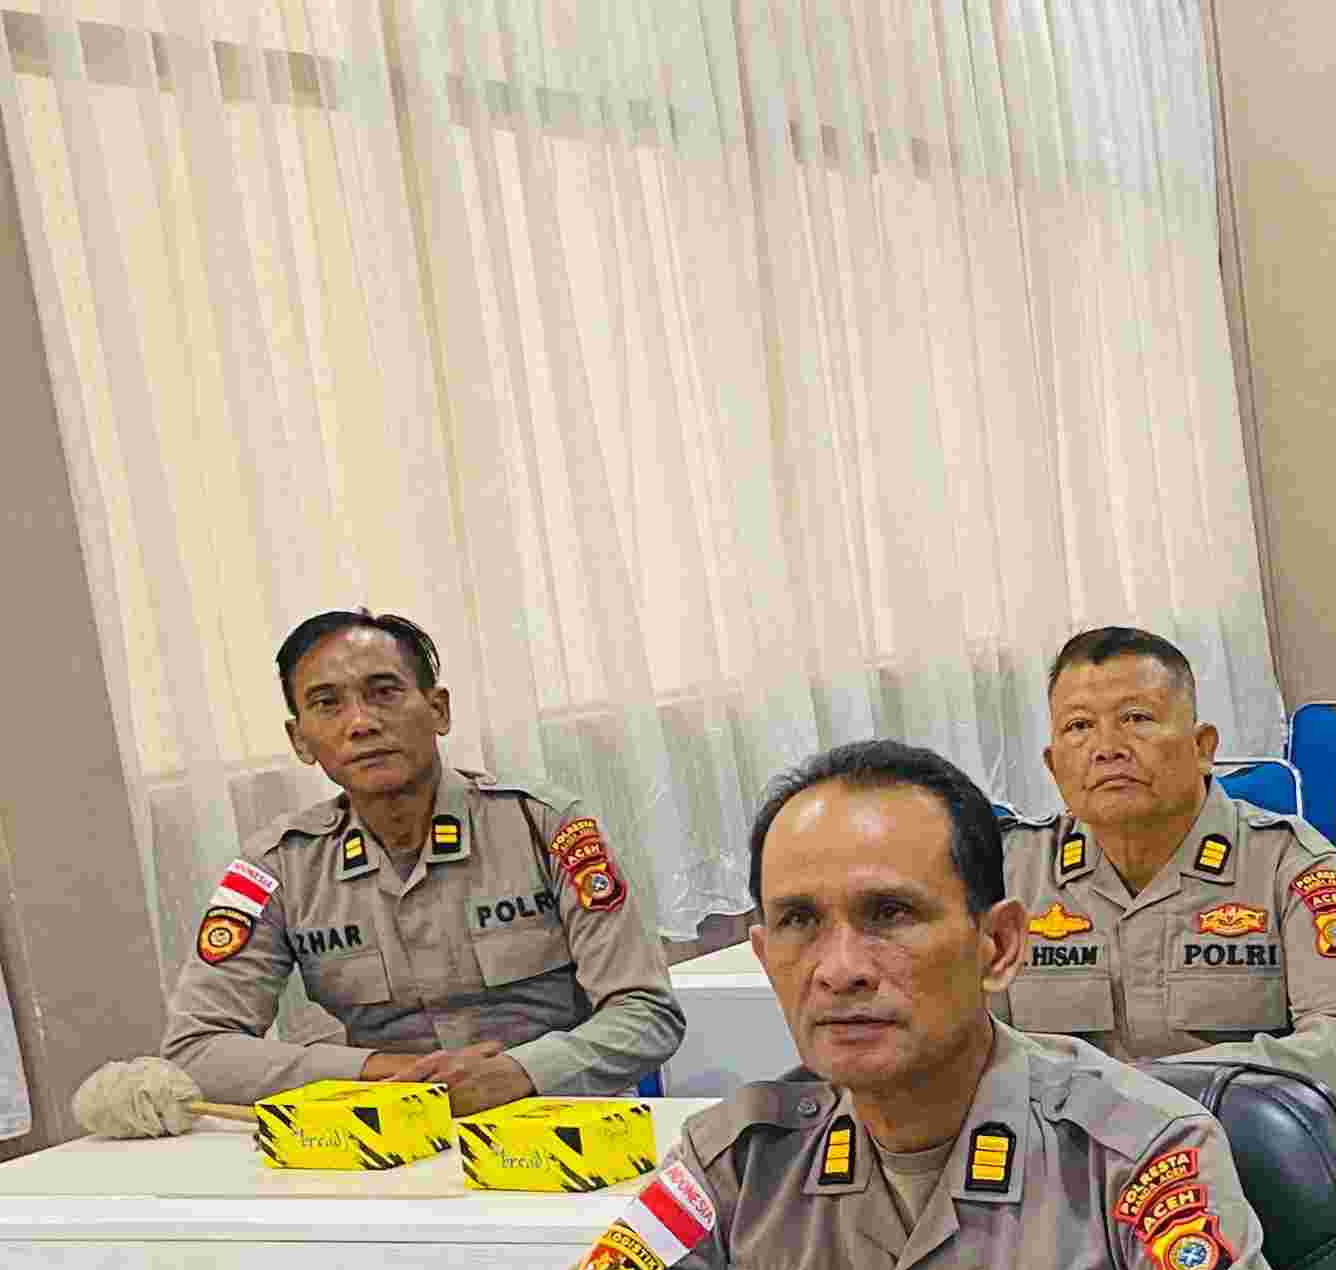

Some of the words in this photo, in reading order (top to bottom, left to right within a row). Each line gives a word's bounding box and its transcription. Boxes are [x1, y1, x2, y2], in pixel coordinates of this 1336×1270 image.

[1183, 943, 1279, 966] POLRI
[1118, 1151, 1190, 1216] POLRESTA
[1142, 1189, 1196, 1233] ACEH
